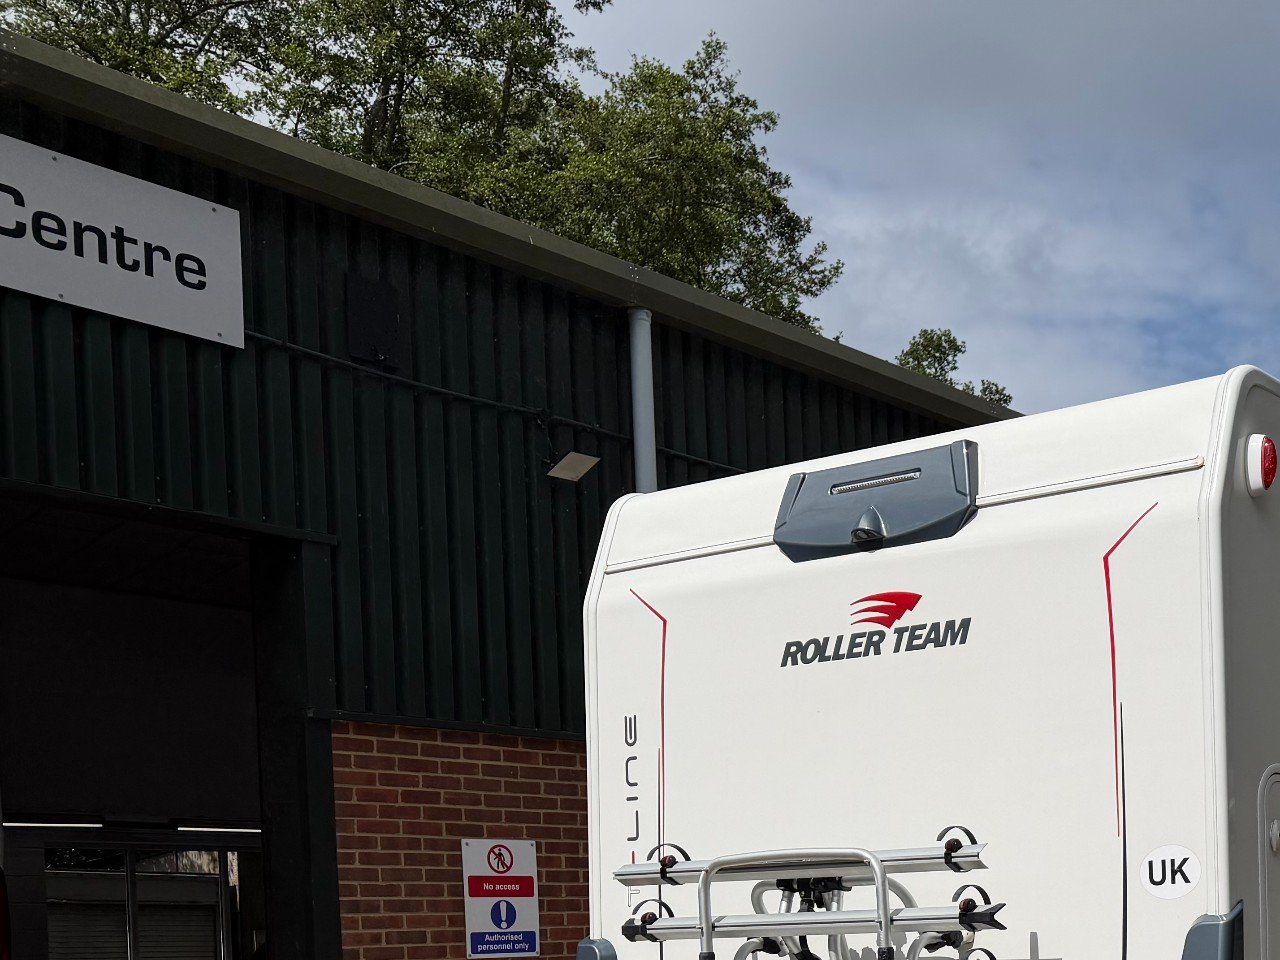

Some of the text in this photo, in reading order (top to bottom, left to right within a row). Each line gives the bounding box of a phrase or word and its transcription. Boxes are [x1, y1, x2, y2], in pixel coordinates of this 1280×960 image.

[780, 617, 972, 667] ROLLER TEAM
[1148, 857, 1191, 886] UK
[483, 882, 520, 891] No access
[484, 932, 523, 942] Authorised
[477, 942, 530, 952] personnel only
